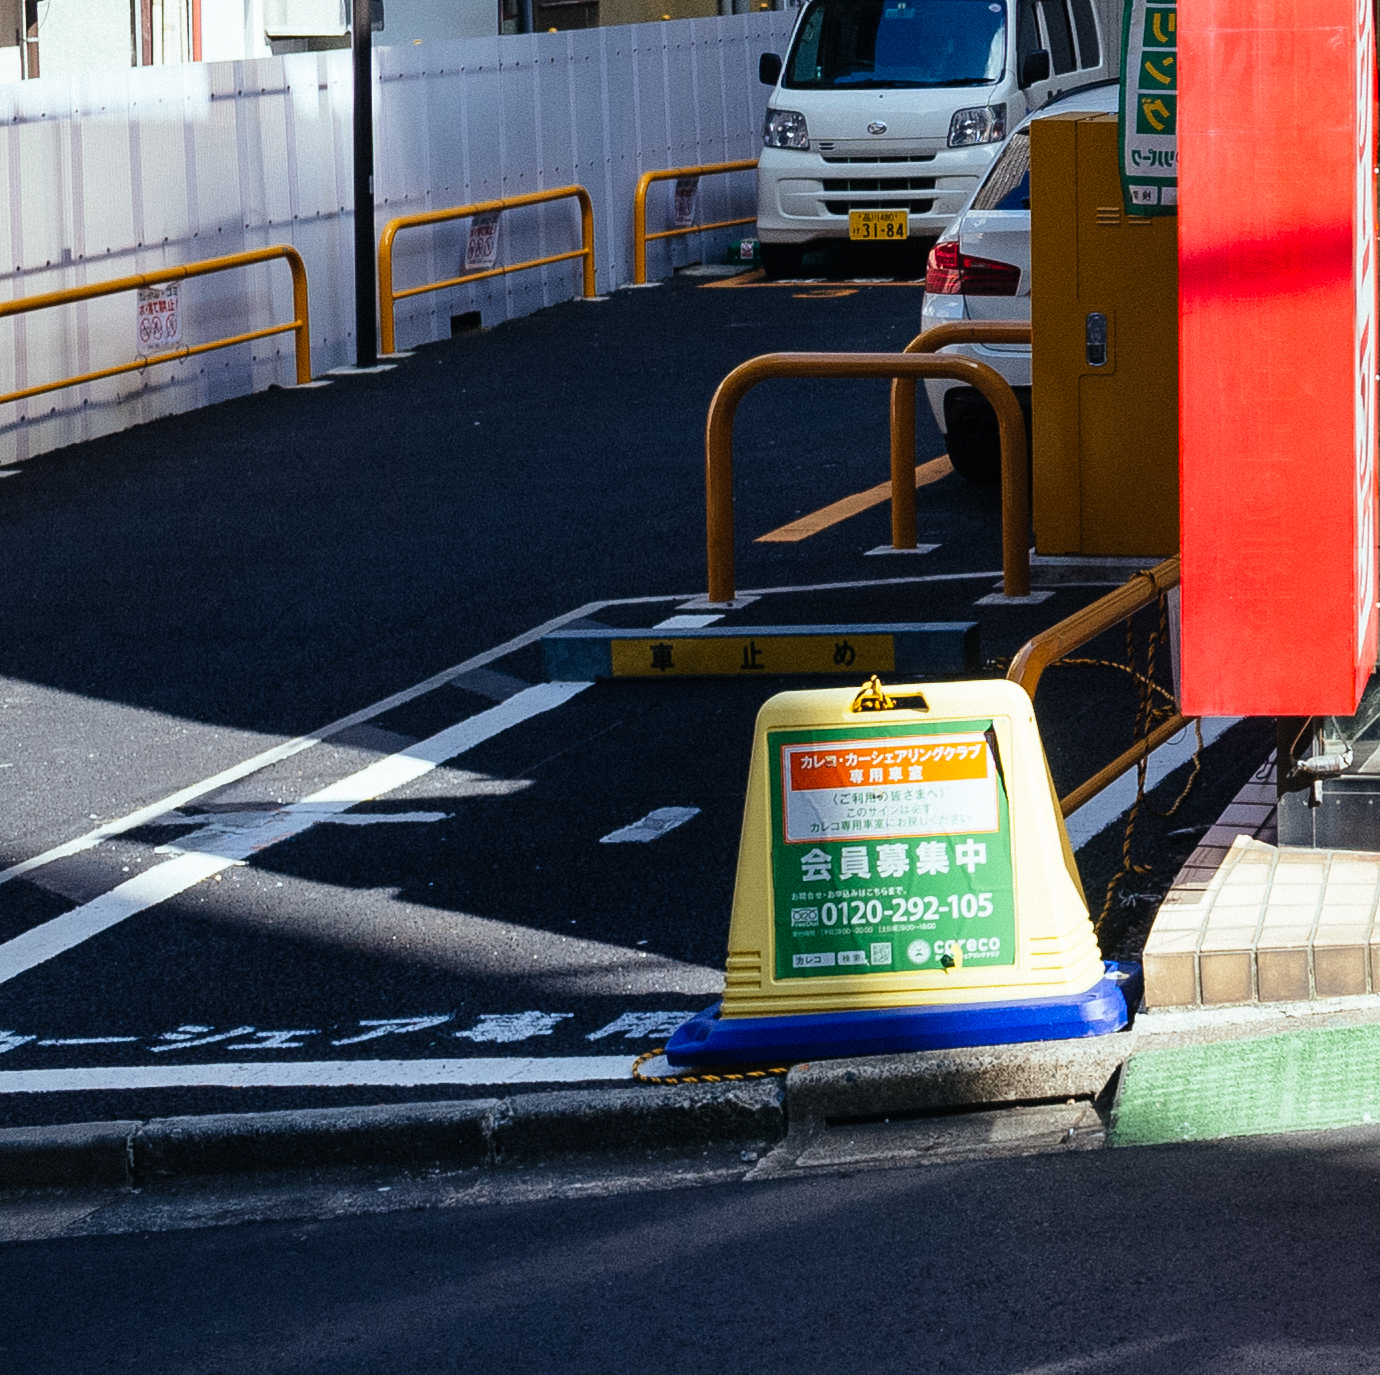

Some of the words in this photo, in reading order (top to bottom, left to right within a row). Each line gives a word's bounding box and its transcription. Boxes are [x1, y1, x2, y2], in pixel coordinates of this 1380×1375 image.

[862, 222, 904, 238] 31-84
[650, 640, 857, 672] 車止め
[849, 764, 924, 784] 専用車室
[800, 838, 988, 882] 会員募集中
[821, 892, 994, 926] 0120-292-105
[795, 955, 822, 966] カレコ
